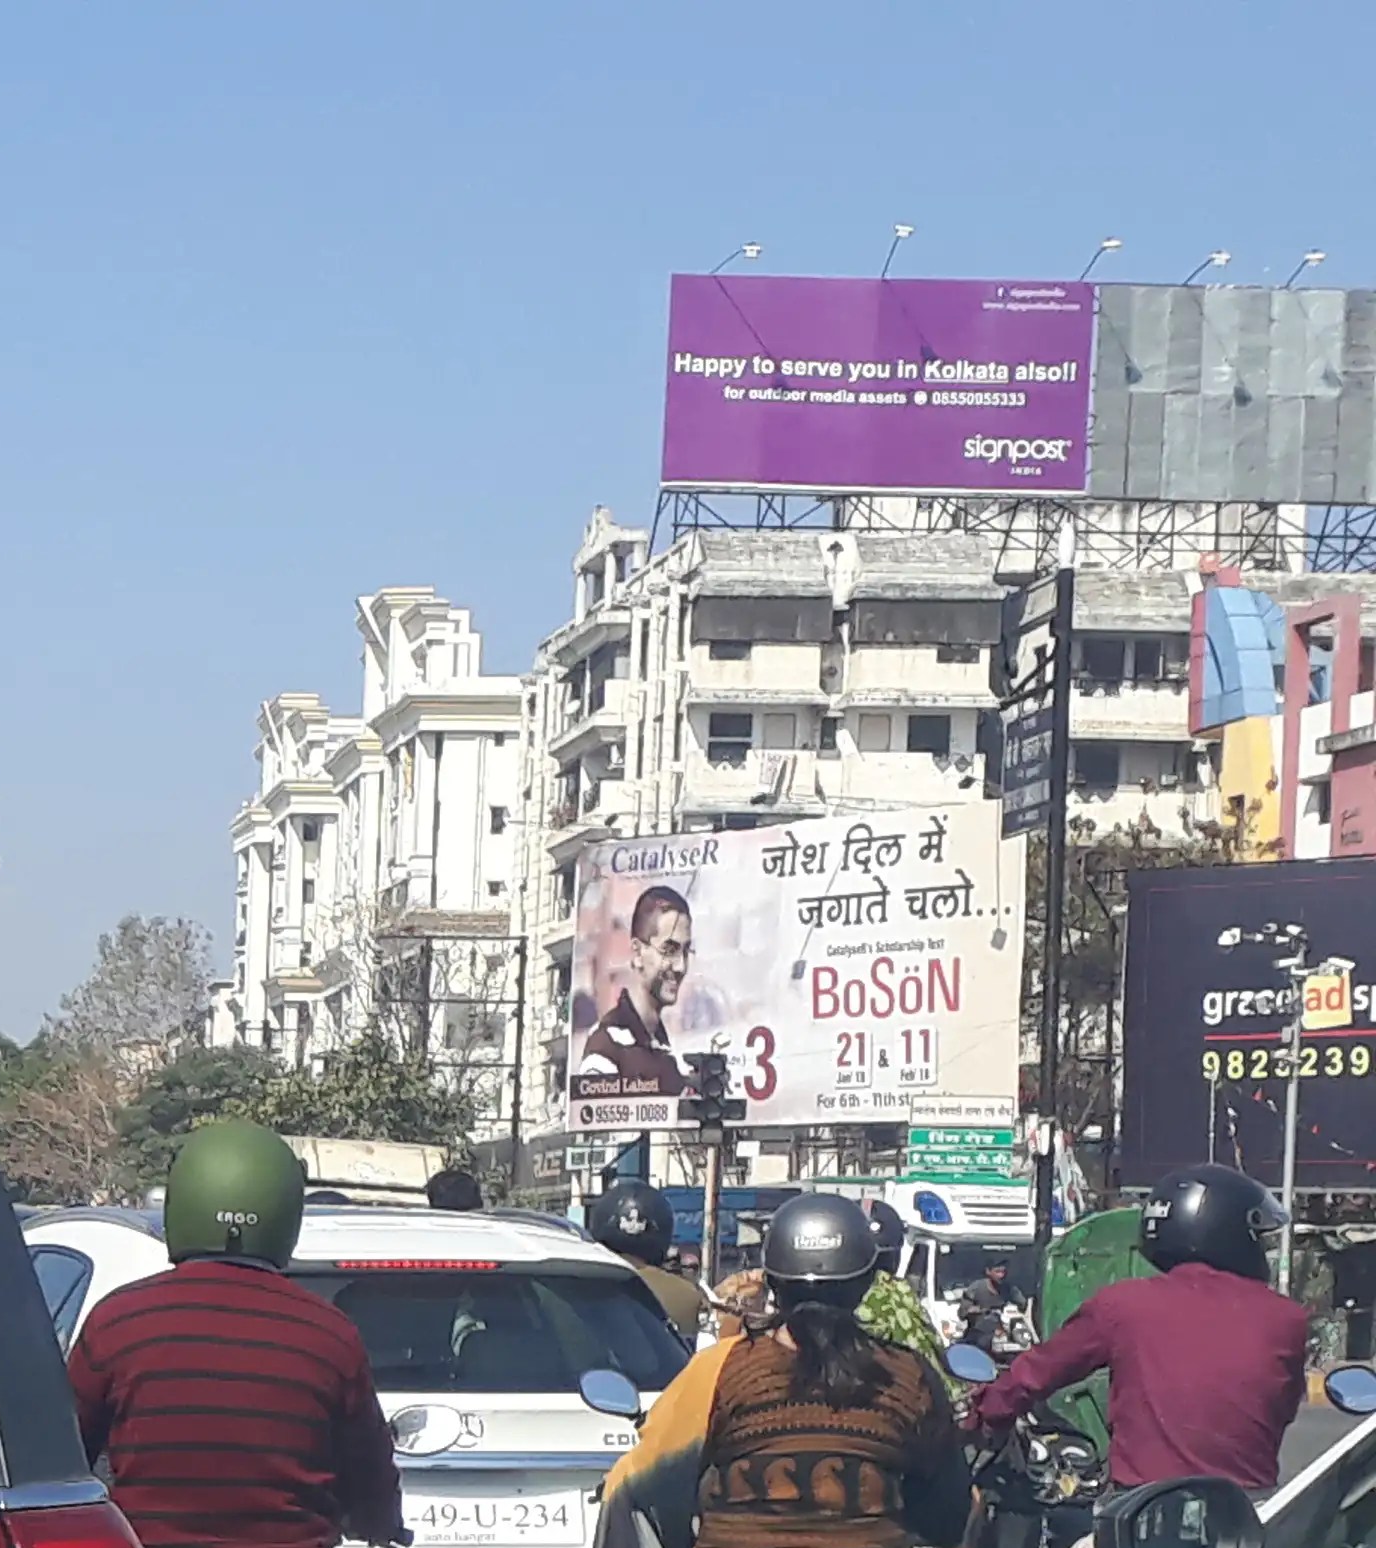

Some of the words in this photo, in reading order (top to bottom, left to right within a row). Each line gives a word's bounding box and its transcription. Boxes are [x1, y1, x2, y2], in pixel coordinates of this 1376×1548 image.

[674, 353, 746, 379] Happy
[752, 355, 775, 374] to
[781, 359, 843, 377] serve
[848, 361, 891, 382] you
[898, 359, 918, 378] in
[924, 360, 1009, 380] Kolkata
[724, 385, 745, 399] for
[810, 389, 854, 402] media
[964, 433, 1068, 464] signpost
[762, 831, 830, 877] जोश
[841, 823, 906, 874] दिल
[919, 814, 949, 863] में
[798, 875, 890, 928] जगाते
[813, 956, 961, 1019] BoSöN
[1305, 977, 1345, 1012] ad
[837, 1032, 865, 1067] 21
[878, 1049, 889, 1068] &
[901, 1029, 930, 1064] 11
[816, 1094, 836, 1108] For
